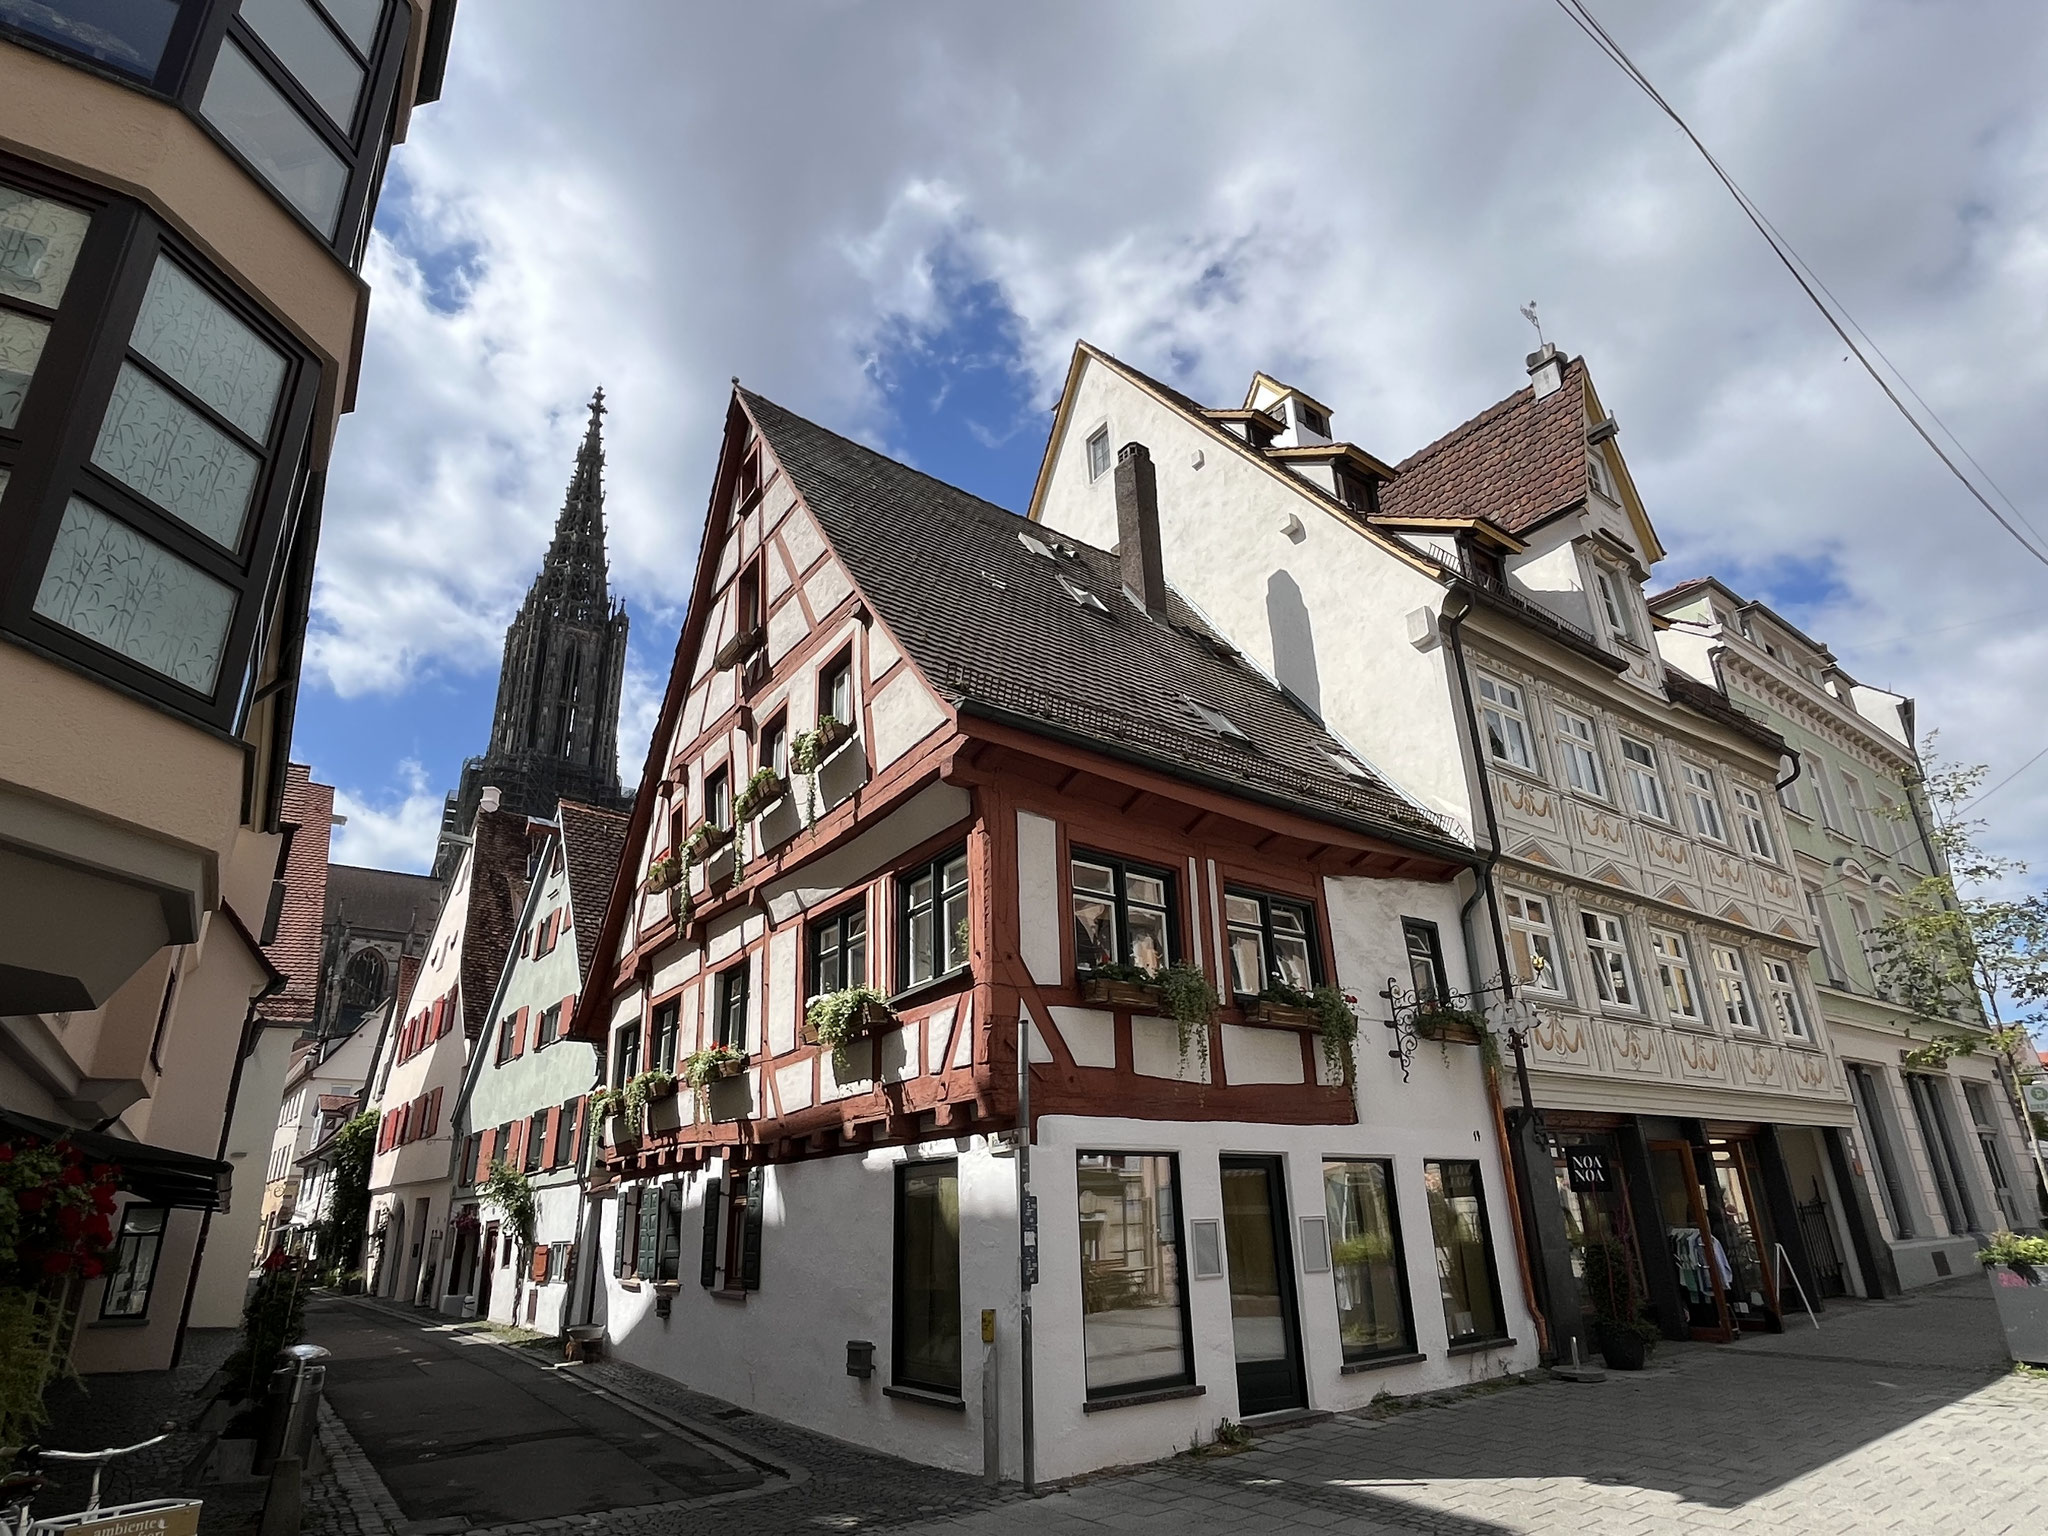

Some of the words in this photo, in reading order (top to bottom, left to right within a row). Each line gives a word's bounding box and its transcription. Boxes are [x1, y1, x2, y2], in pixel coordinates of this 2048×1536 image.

[1572, 1155, 1602, 1169] NOA
[1574, 1169, 1605, 1182] NOA
[93, 1519, 157, 1536] ambiente
